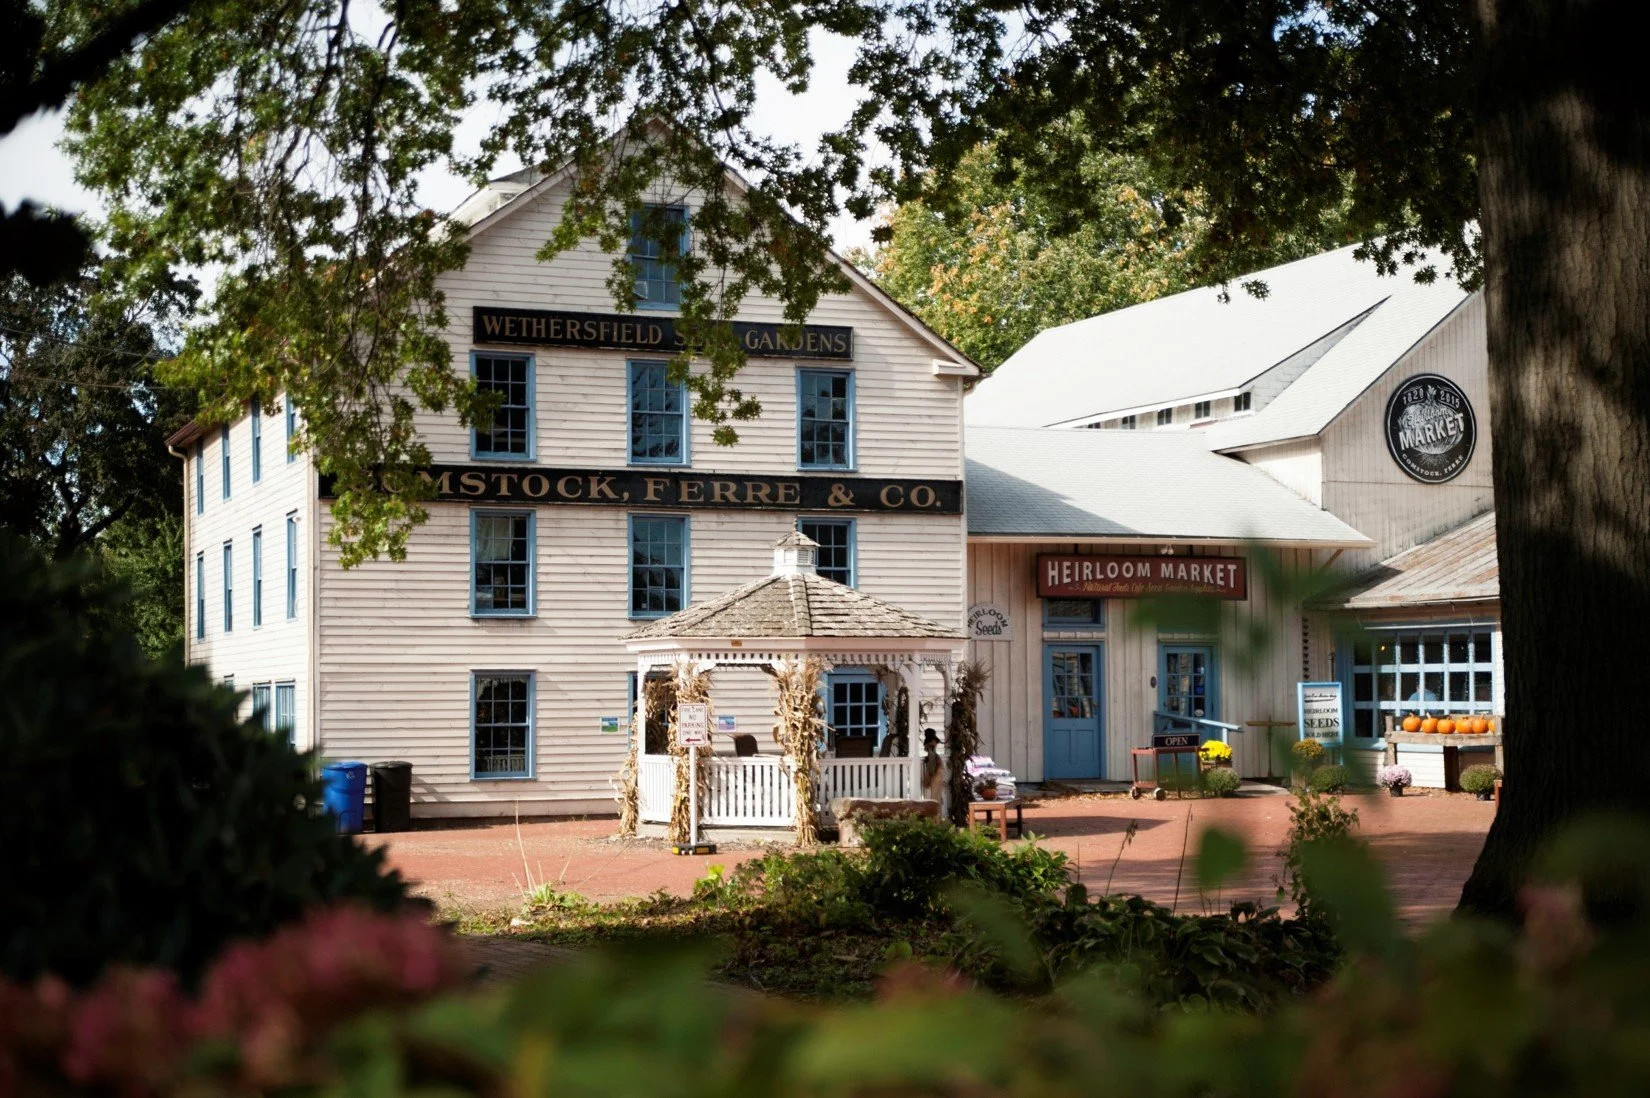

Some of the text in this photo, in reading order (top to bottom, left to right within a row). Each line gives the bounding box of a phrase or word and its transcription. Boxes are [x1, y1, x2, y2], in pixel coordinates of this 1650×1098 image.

[481, 314, 662, 345] WETHERSFIELD
[1403, 387, 1460, 409] 1820 2015
[1399, 412, 1465, 451] MARKET
[643, 477, 800, 505] FERRE
[827, 482, 856, 508] &
[879, 484, 942, 509] CO.
[1048, 560, 1238, 589] HEIRLOOM MARKET
[967, 608, 1009, 628] HEIRLOOM
[975, 620, 1002, 636] Seeds
[1304, 718, 1340, 729] SEEDS
[1165, 736, 1188, 747] OPEN
[1304, 731, 1321, 739] SOLD
